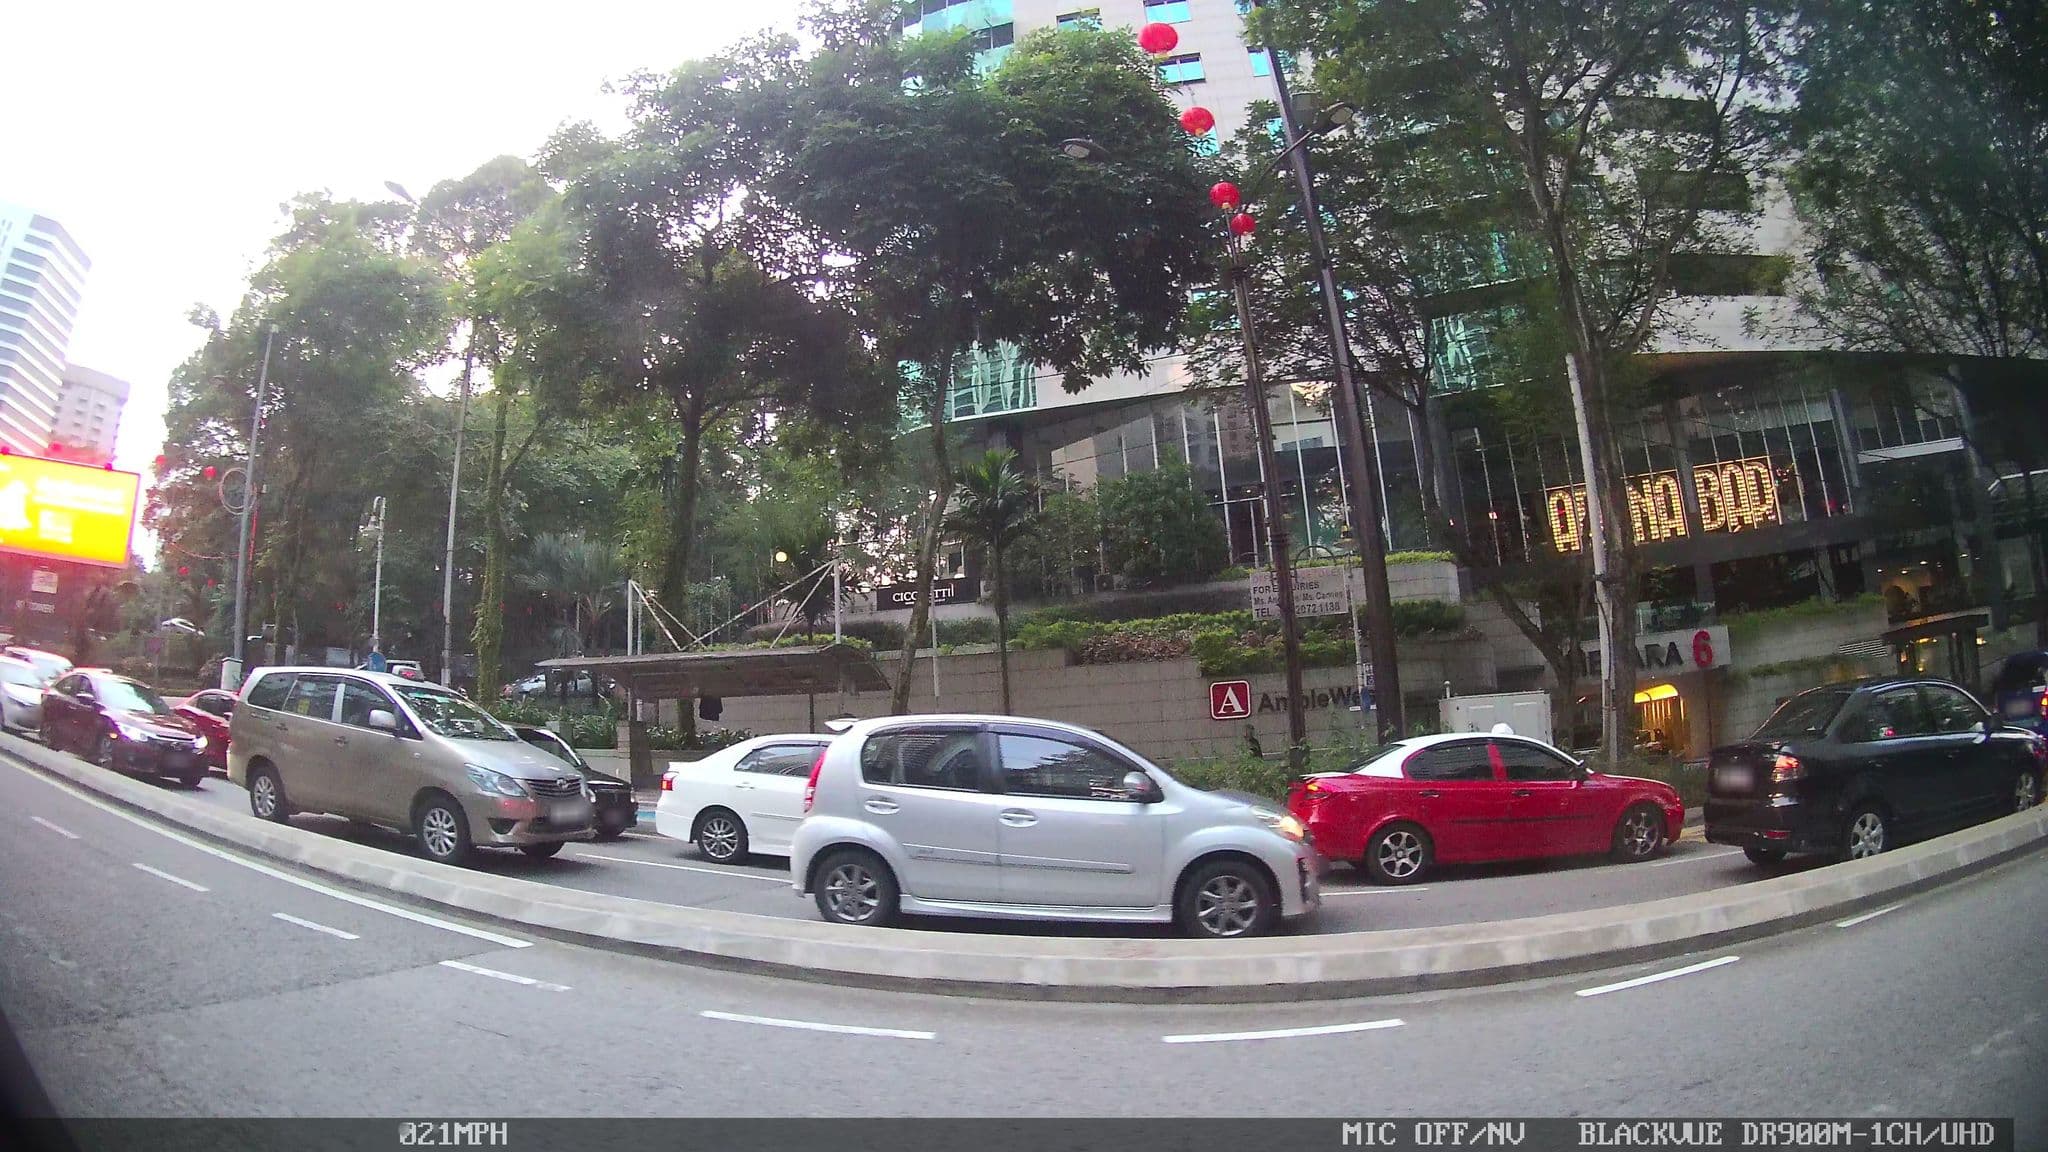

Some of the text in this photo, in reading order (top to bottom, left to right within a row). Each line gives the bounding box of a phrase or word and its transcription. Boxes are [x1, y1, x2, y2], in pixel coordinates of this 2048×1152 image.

[1693, 462, 1776, 531] BAR
[1253, 585, 1271, 595] FOR
[1692, 630, 1713, 668] 6
[1218, 686, 1245, 713] A
